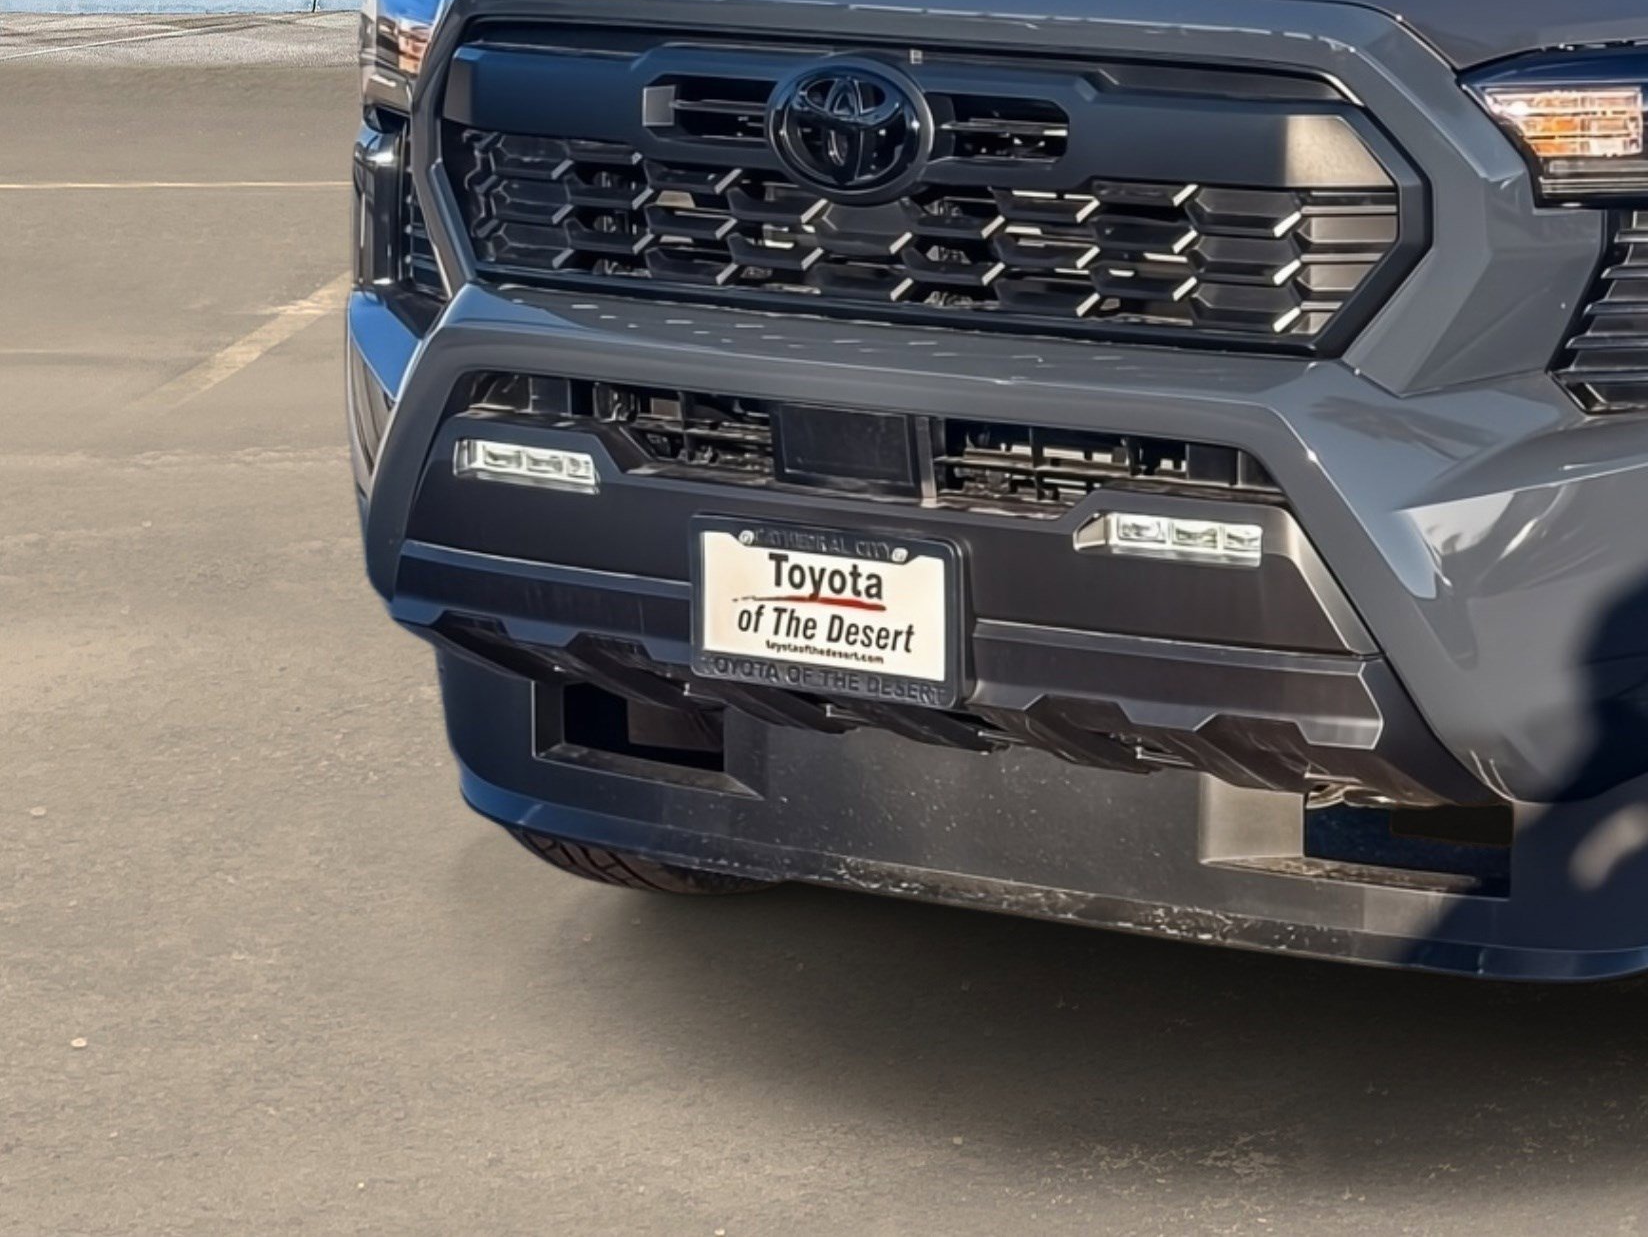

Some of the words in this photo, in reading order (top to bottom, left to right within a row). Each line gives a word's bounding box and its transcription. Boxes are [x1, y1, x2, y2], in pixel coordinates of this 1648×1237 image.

[855, 540, 891, 561] CITY
[768, 552, 883, 601] Toyota
[737, 605, 766, 633] of
[773, 607, 817, 640] The
[826, 614, 915, 653] Desert
[765, 639, 884, 664] toyotaofthedesert.com
[785, 664, 815, 685] OF
[823, 670, 860, 691] THE
[866, 675, 947, 707] DESERT
